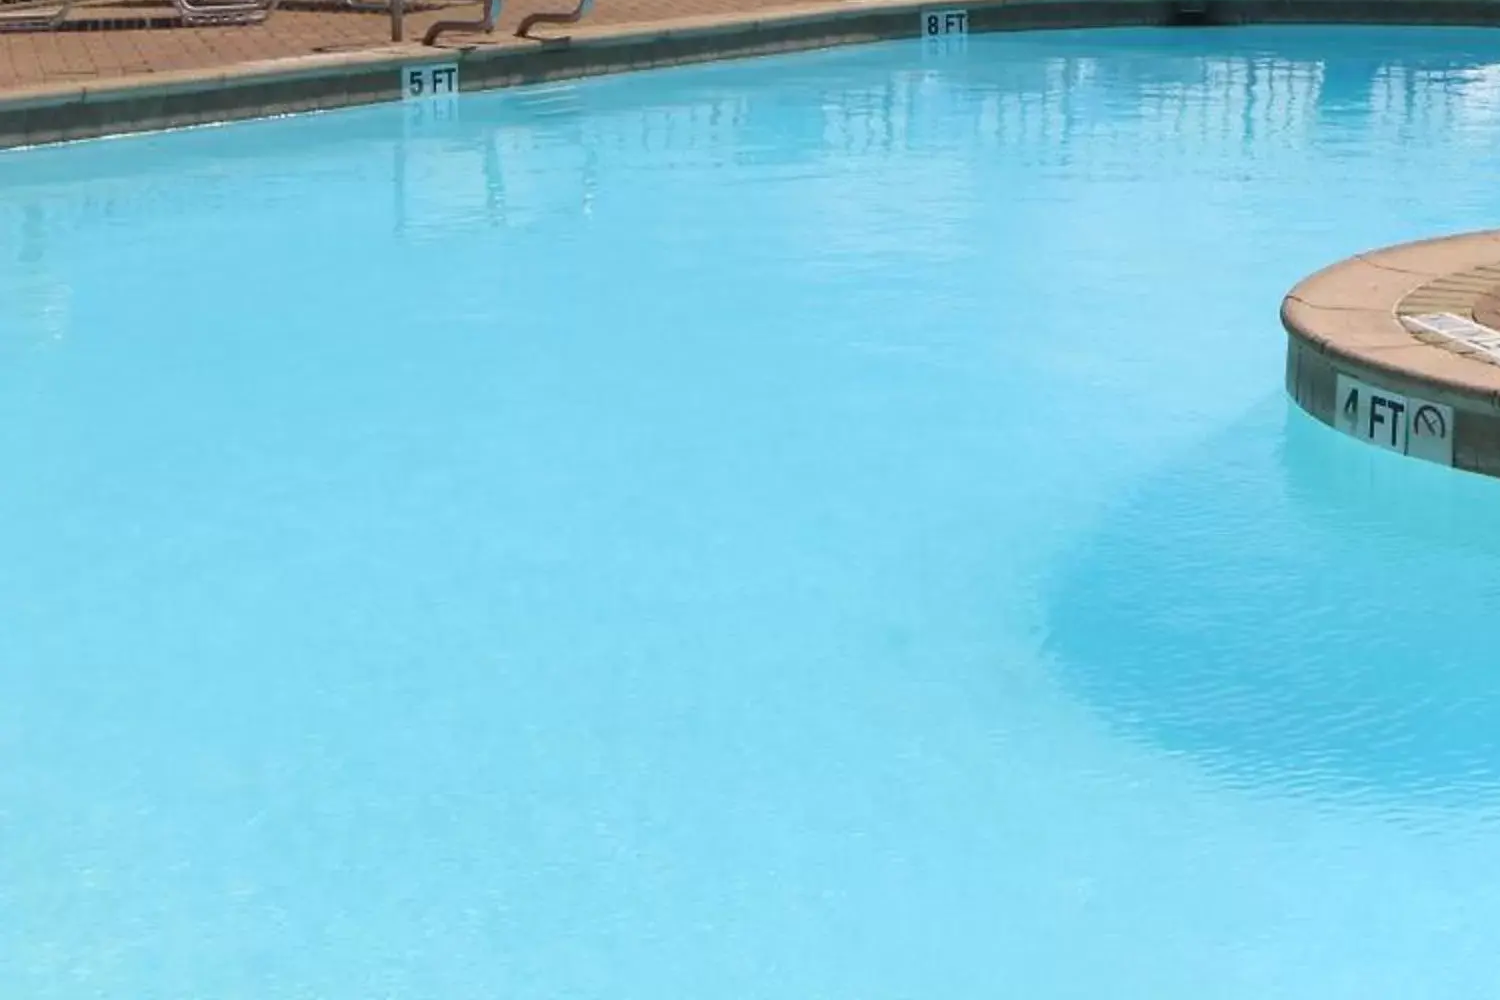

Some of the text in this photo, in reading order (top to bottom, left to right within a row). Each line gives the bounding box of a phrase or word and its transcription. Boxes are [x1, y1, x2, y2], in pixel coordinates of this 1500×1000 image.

[928, 13, 966, 36] 8 FT
[409, 68, 457, 97] 5 FT
[1344, 388, 1405, 447] 4 FT
